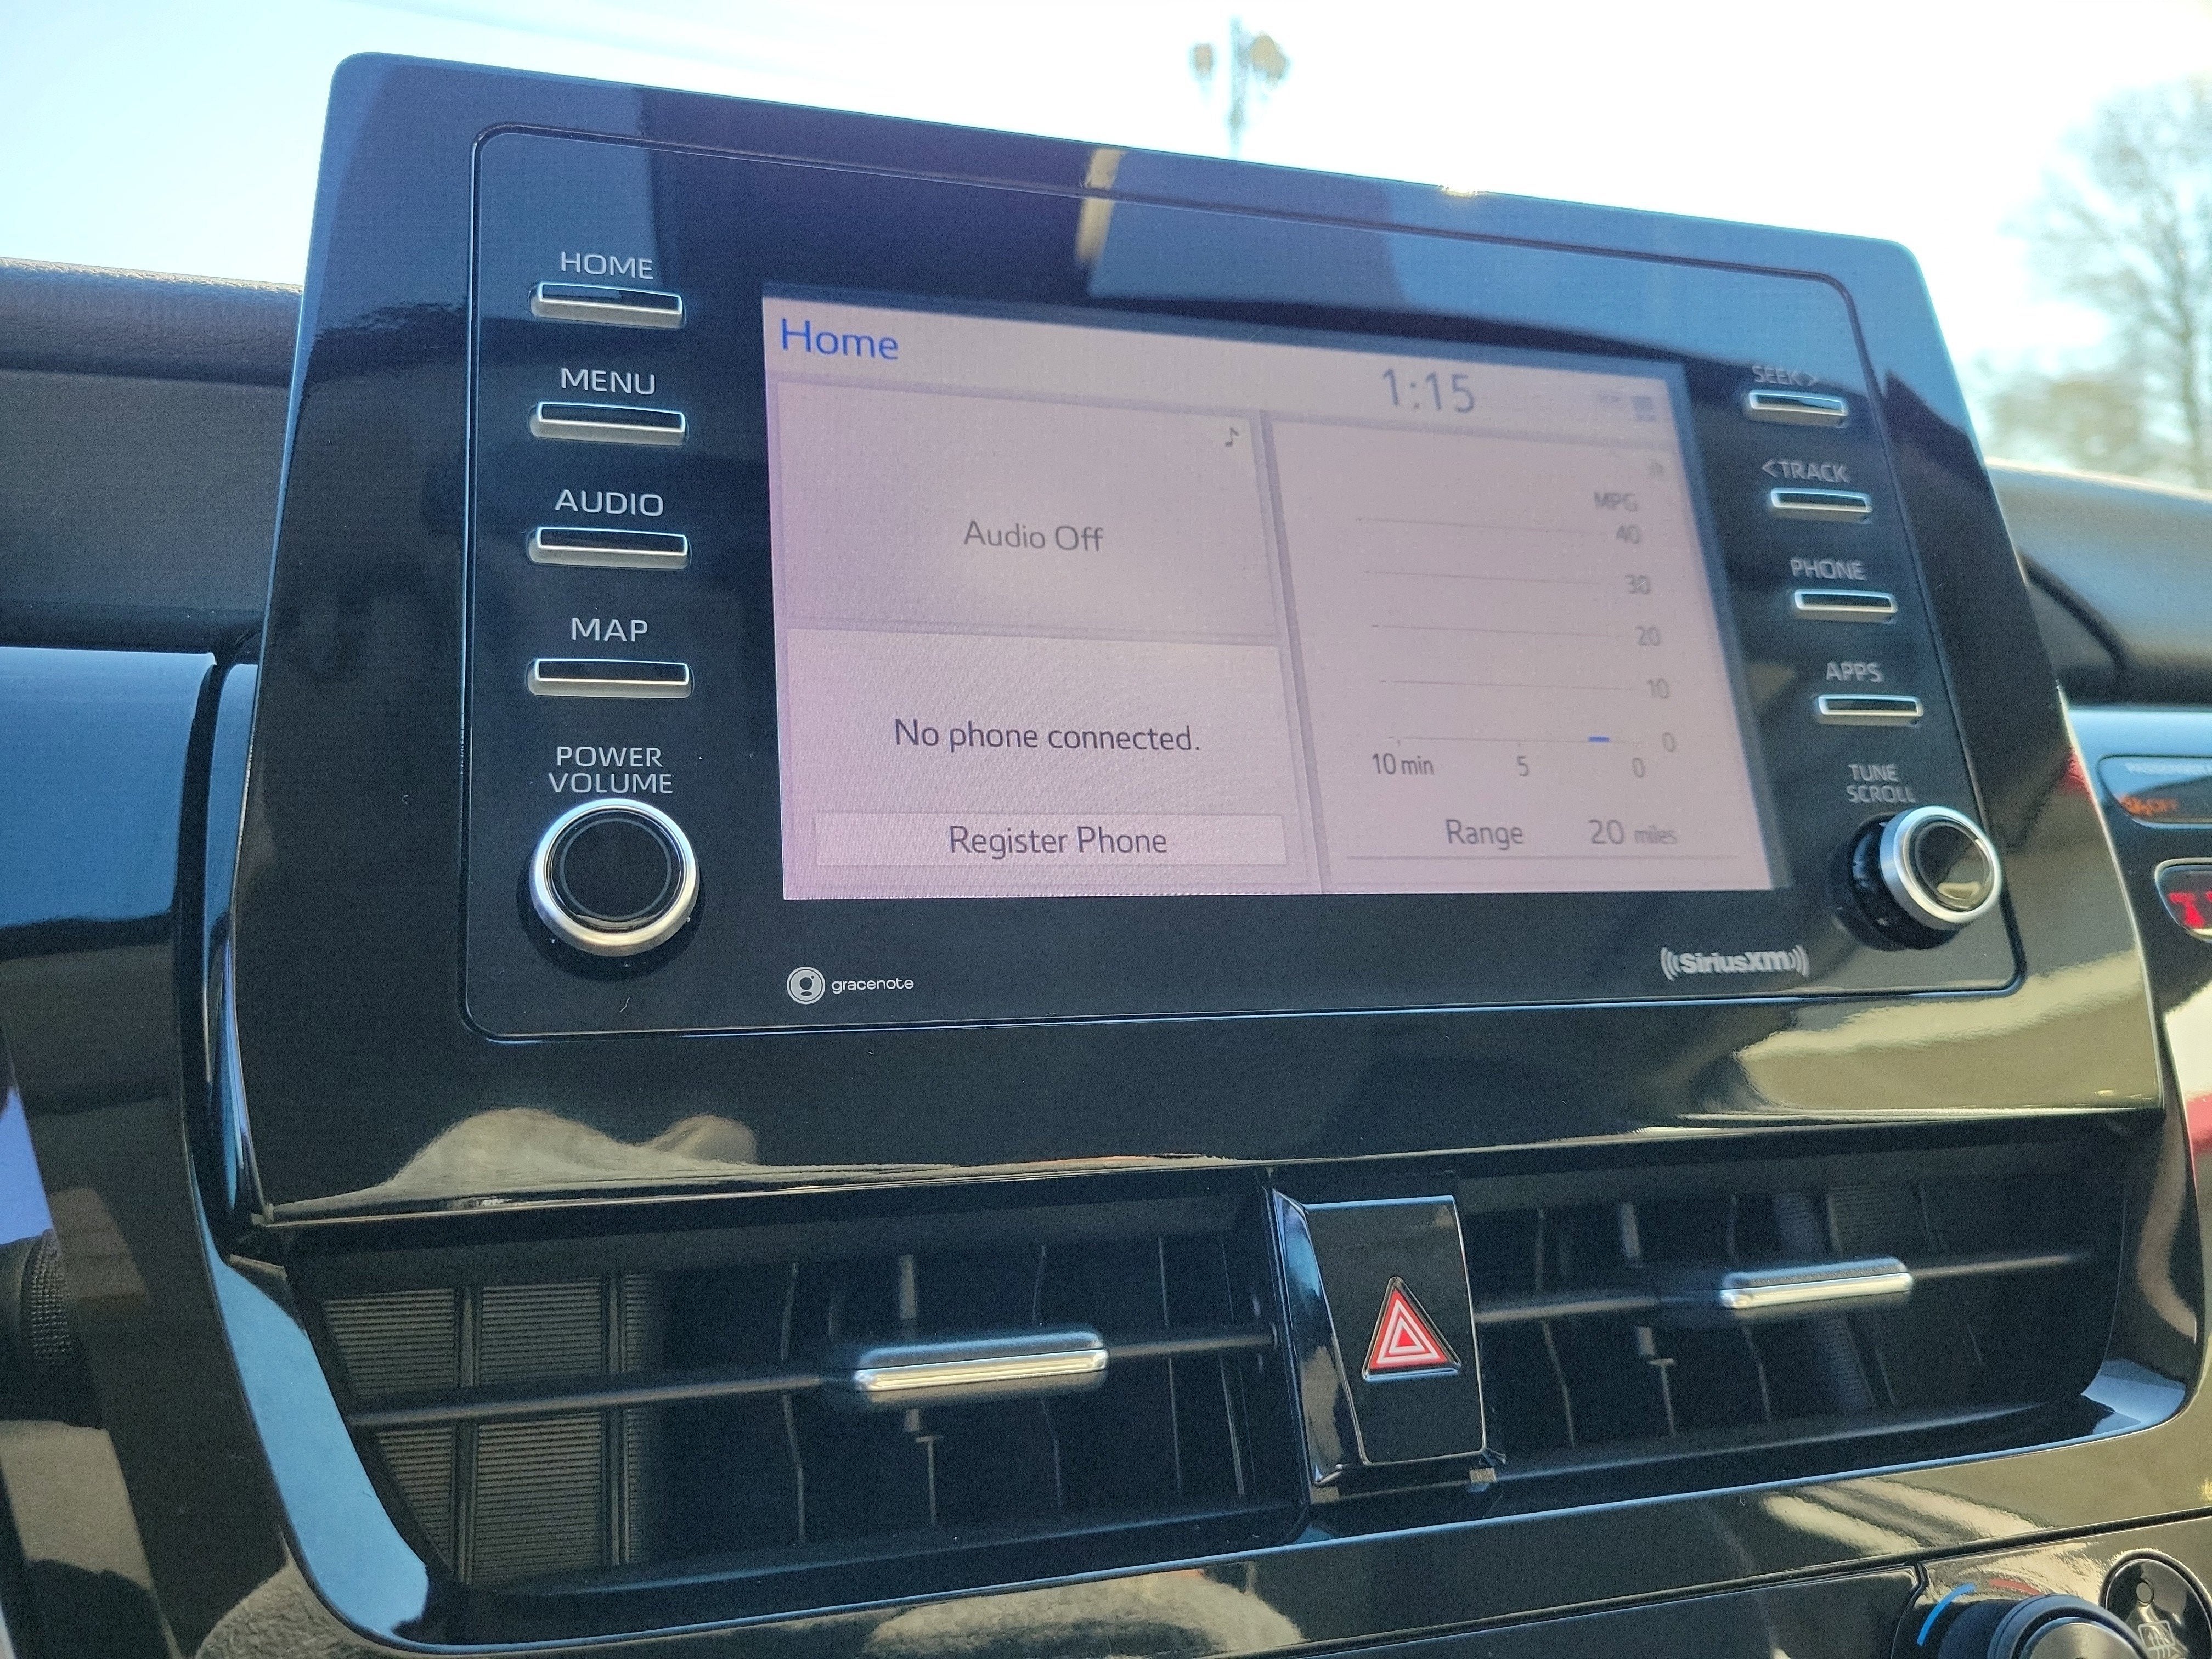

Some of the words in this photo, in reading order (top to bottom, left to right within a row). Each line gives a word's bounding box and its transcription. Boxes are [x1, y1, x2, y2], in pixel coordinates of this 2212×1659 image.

[561, 251, 654, 280] HOME
[781, 318, 899, 360] Home
[560, 367, 656, 396] MENU
[1382, 368, 1475, 414] 1:15
[554, 489, 664, 517] AUDIO
[1593, 492, 1639, 513] MPG
[963, 520, 1046, 550] Audio
[1054, 525, 1104, 552] Off
[1616, 524, 1641, 545] 40
[1790, 557, 1866, 581] PHONE
[1625, 574, 1652, 595] 30
[571, 617, 649, 642] MAP
[1635, 625, 1662, 647] 20
[1825, 661, 1884, 684] APPS
[1647, 678, 1671, 700] 10
[894, 718, 939, 747] No
[949, 720, 1039, 753] phone
[1047, 725, 1200, 752] connected.
[556, 746, 664, 768] POWER
[1372, 753, 1397, 775] 10
[1401, 755, 1435, 775] min
[1516, 755, 1530, 777] 5
[548, 772, 674, 794] VOLUME
[1847, 764, 1899, 783] TUNE
[1846, 785, 1916, 804] SCROLL
[949, 825, 1069, 860] Register
[1077, 826, 1169, 854] Phone
[1445, 819, 1525, 851] Range
[1588, 819, 1626, 845] 20
[1633, 823, 1679, 845] miles
[831, 977, 915, 995] gracenote
